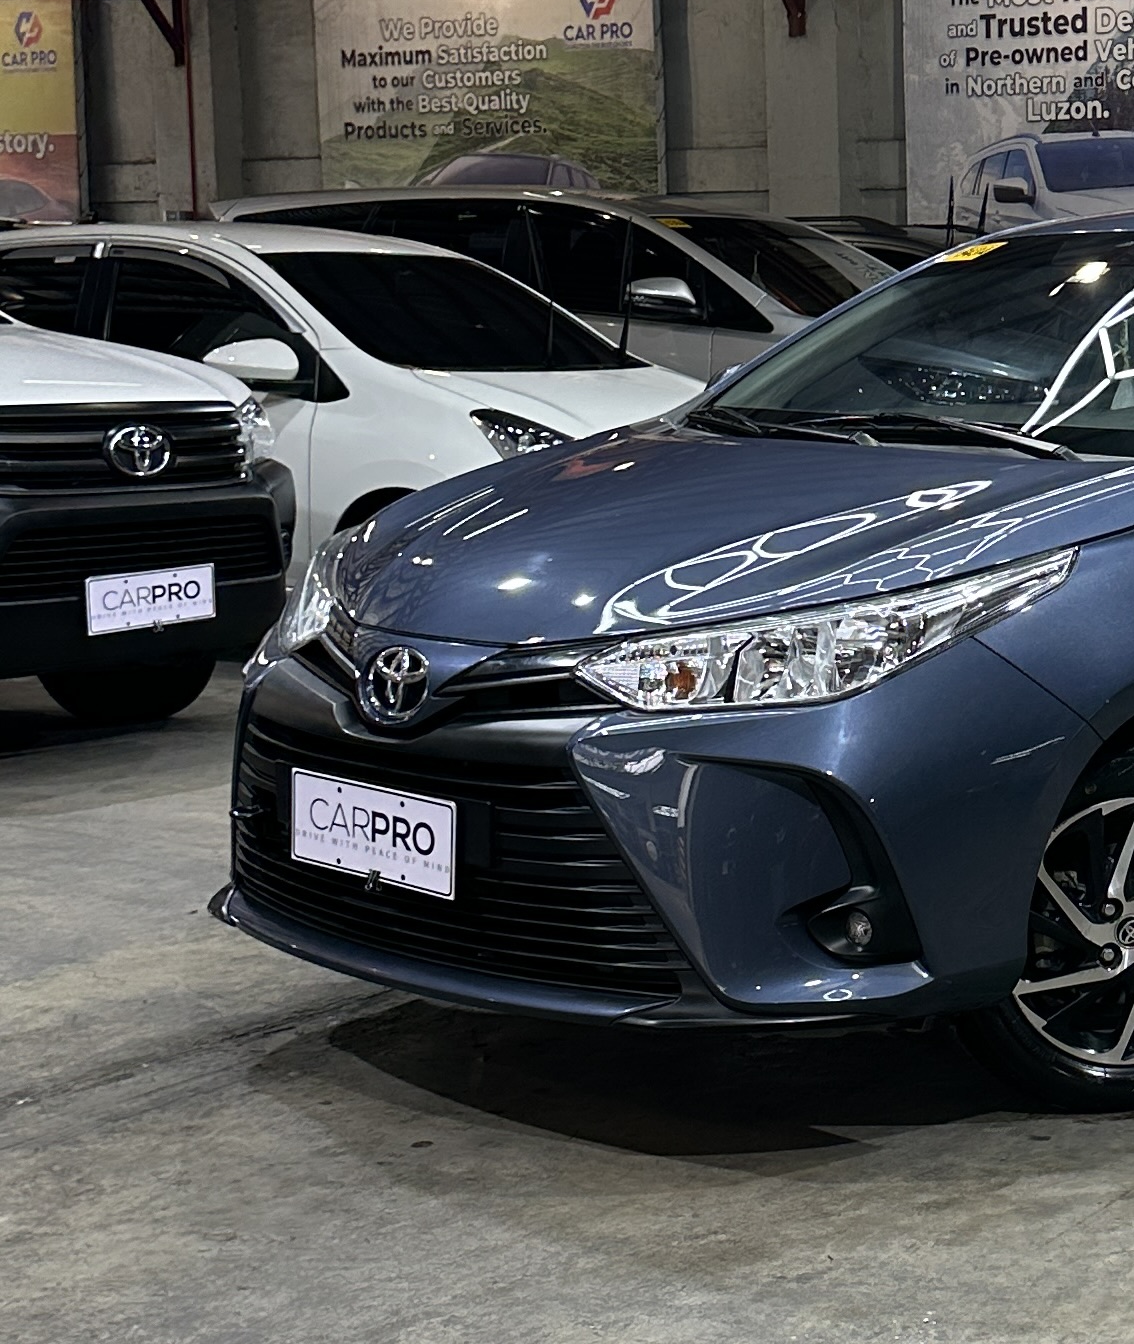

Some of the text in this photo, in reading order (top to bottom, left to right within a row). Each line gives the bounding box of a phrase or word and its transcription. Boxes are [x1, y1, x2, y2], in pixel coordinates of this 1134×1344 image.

[379, 12, 499, 41] We Provide
[563, 22, 633, 41] CAR PRO
[948, 19, 978, 38] and
[980, 7, 1088, 38] Trusted
[2, 49, 58, 67] CAR PRO
[341, 46, 432, 68] Maximum
[437, 40, 548, 65] Satisfaction
[939, 50, 957, 67] of
[965, 40, 1088, 66] Pre-owned
[372, 69, 522, 89] to our Customers
[945, 78, 959, 94] in
[966, 72, 1066, 96] Northern
[1073, 72, 1106, 89] and
[353, 88, 530, 115] with the Best Quality
[1026, 98, 1110, 122] Luzon.
[343, 114, 548, 141] Products and Services.
[102, 580, 201, 611] CARPRO
[309, 798, 436, 857] CARPRO
[331, 837, 359, 852] WITH
[364, 845, 398, 862] PEACE
[403, 855, 418, 866] OF
[423, 860, 451, 875] MIND
